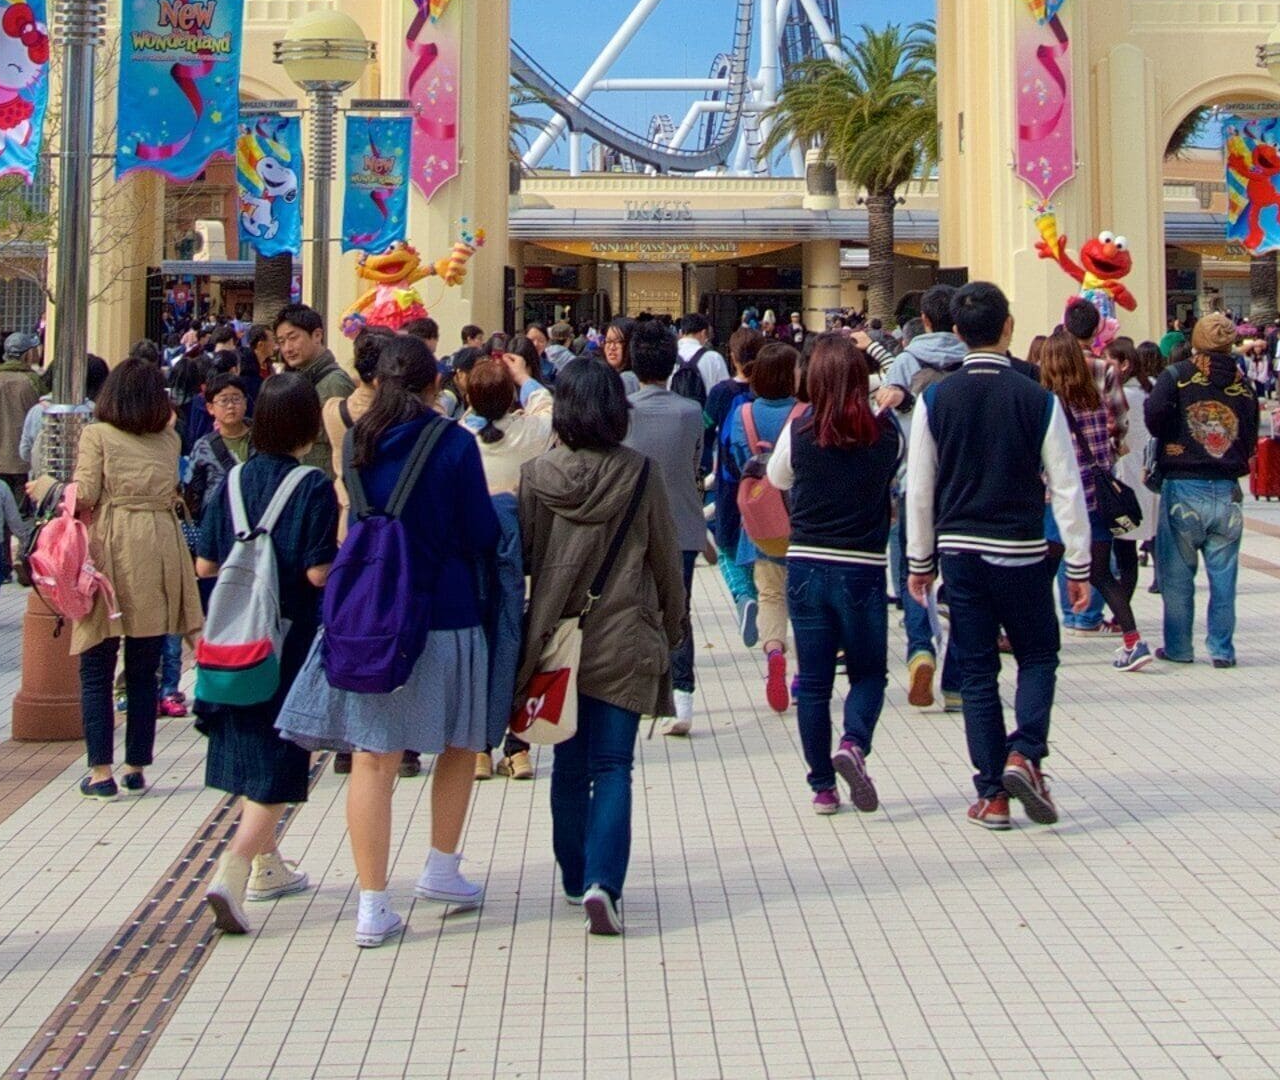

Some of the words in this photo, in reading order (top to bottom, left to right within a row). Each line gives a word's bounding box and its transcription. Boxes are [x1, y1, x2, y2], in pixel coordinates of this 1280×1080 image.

[623, 199, 692, 221] TICKETS
[592, 241, 636, 253] ANNUAL
[639, 241, 664, 253] PASS
